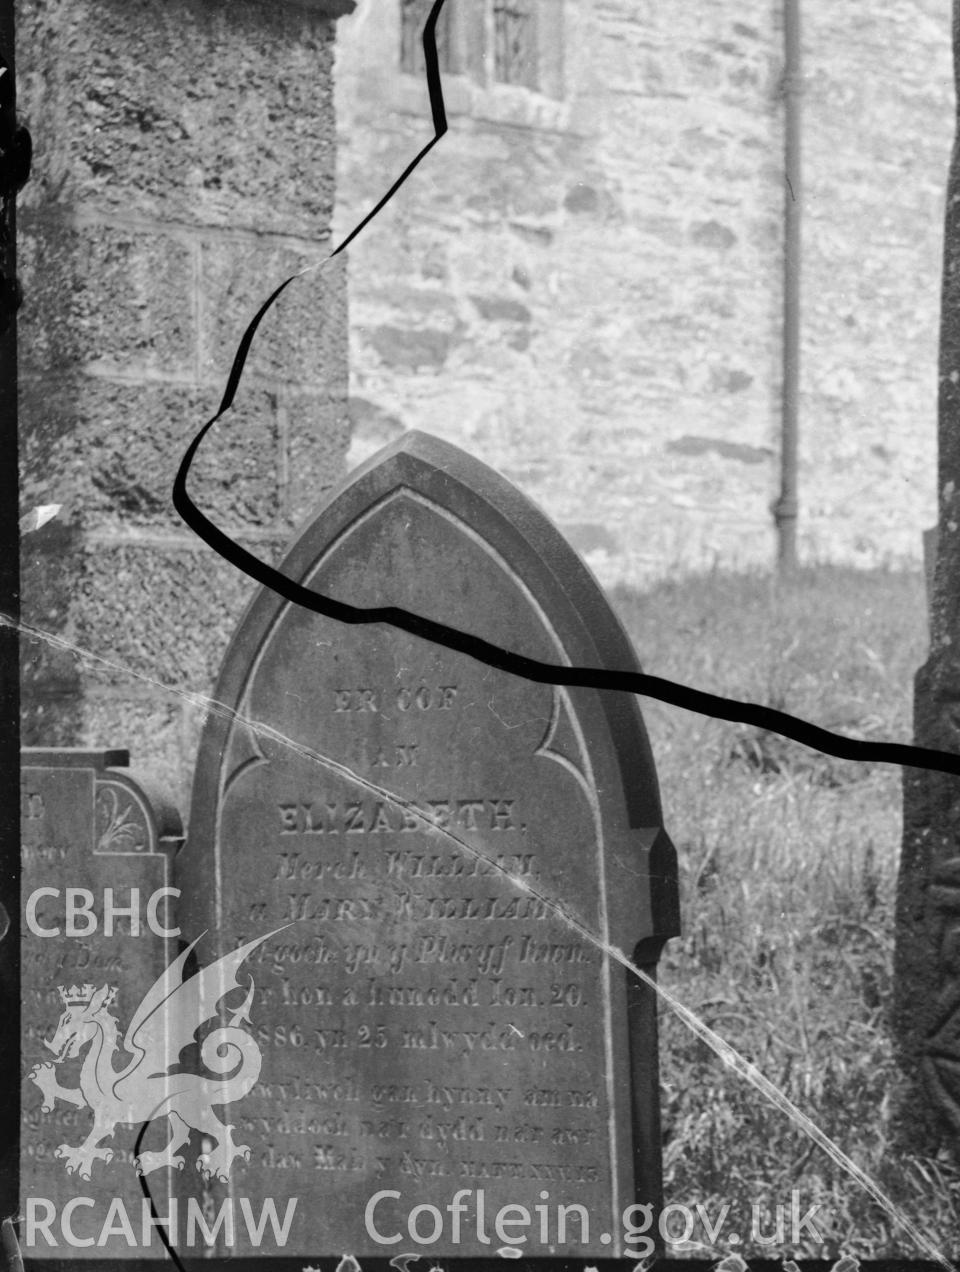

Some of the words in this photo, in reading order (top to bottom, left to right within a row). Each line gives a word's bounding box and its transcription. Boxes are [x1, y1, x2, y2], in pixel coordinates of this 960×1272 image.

[332, 688, 378, 713] ER
[370, 743, 418, 768] AM
[273, 851, 369, 880] Merch
[413, 934, 515, 976] Plwyf
[281, 977, 334, 1007] hon
[342, 987, 360, 1007] a
[314, 1028, 348, 1055] yn
[357, 1025, 389, 1049] 25
